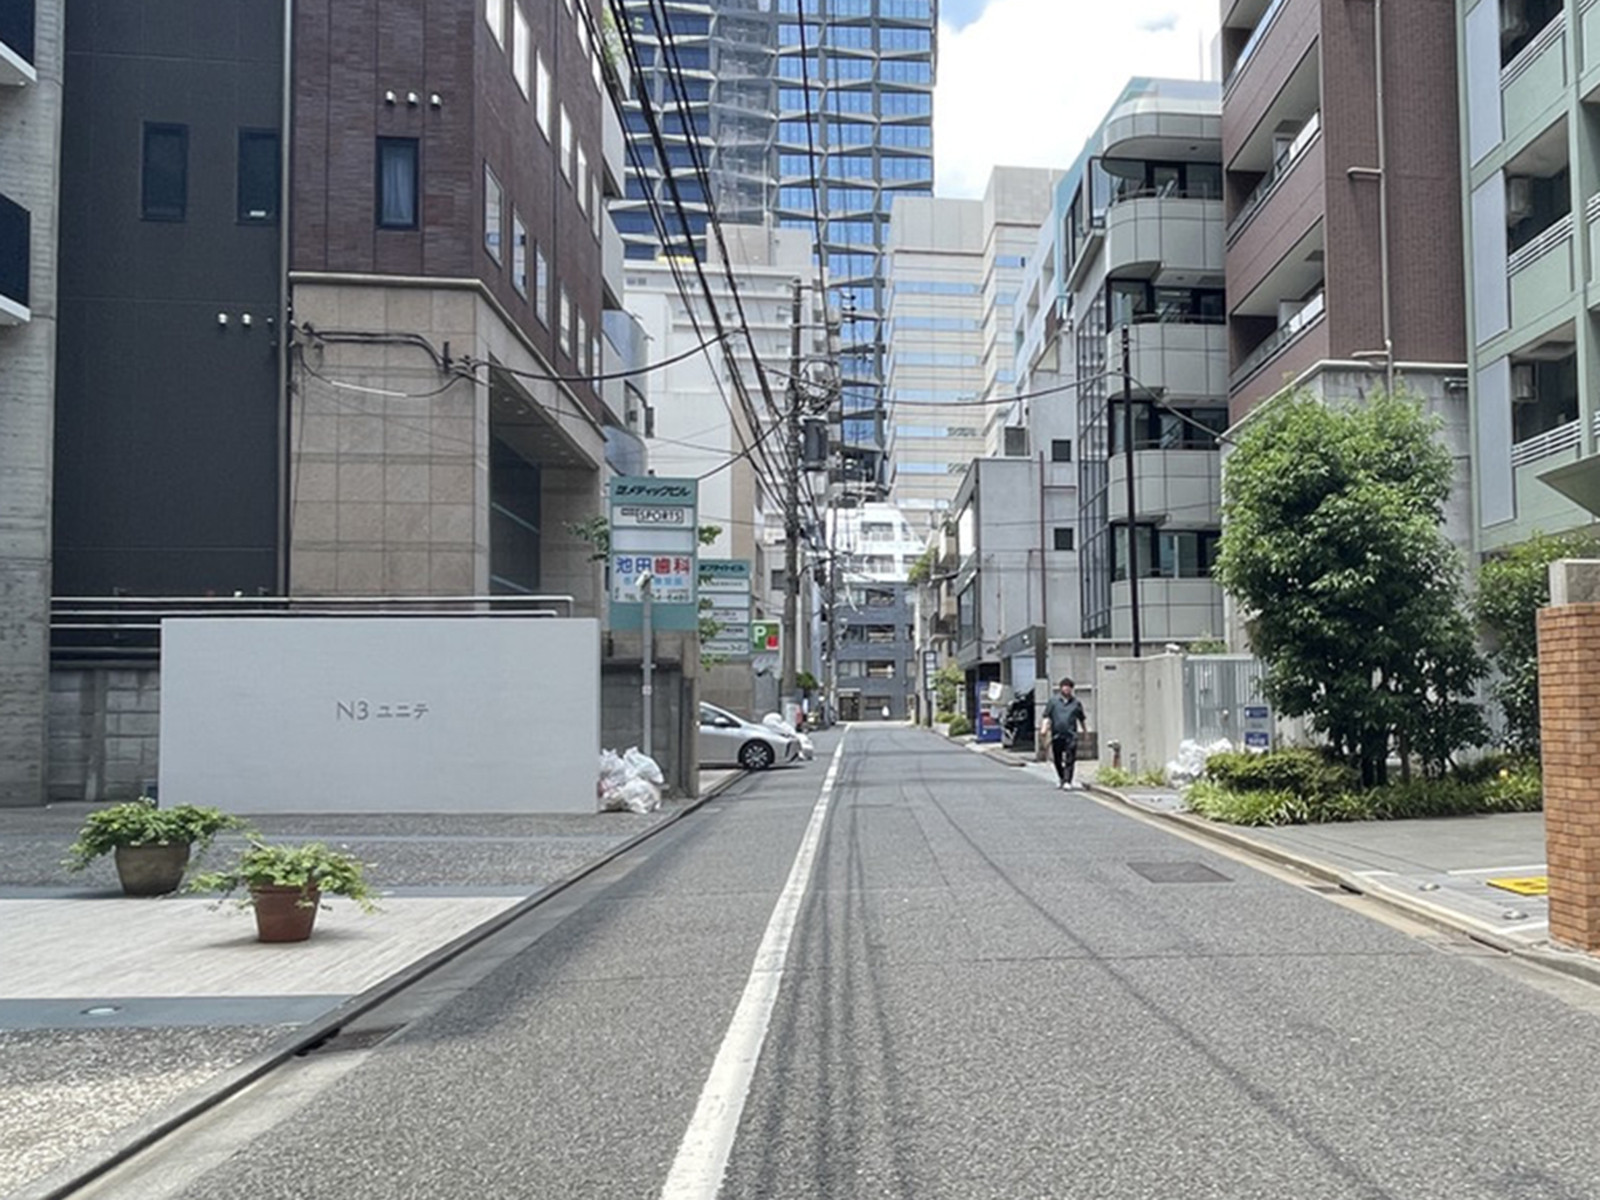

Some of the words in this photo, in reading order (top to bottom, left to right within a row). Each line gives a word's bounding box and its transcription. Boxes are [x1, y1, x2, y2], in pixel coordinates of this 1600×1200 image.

[615, 556, 690, 574] 池田歯科
[754, 625, 767, 643] P
[337, 700, 369, 720] N3
[376, 703, 429, 719] ユニテ
